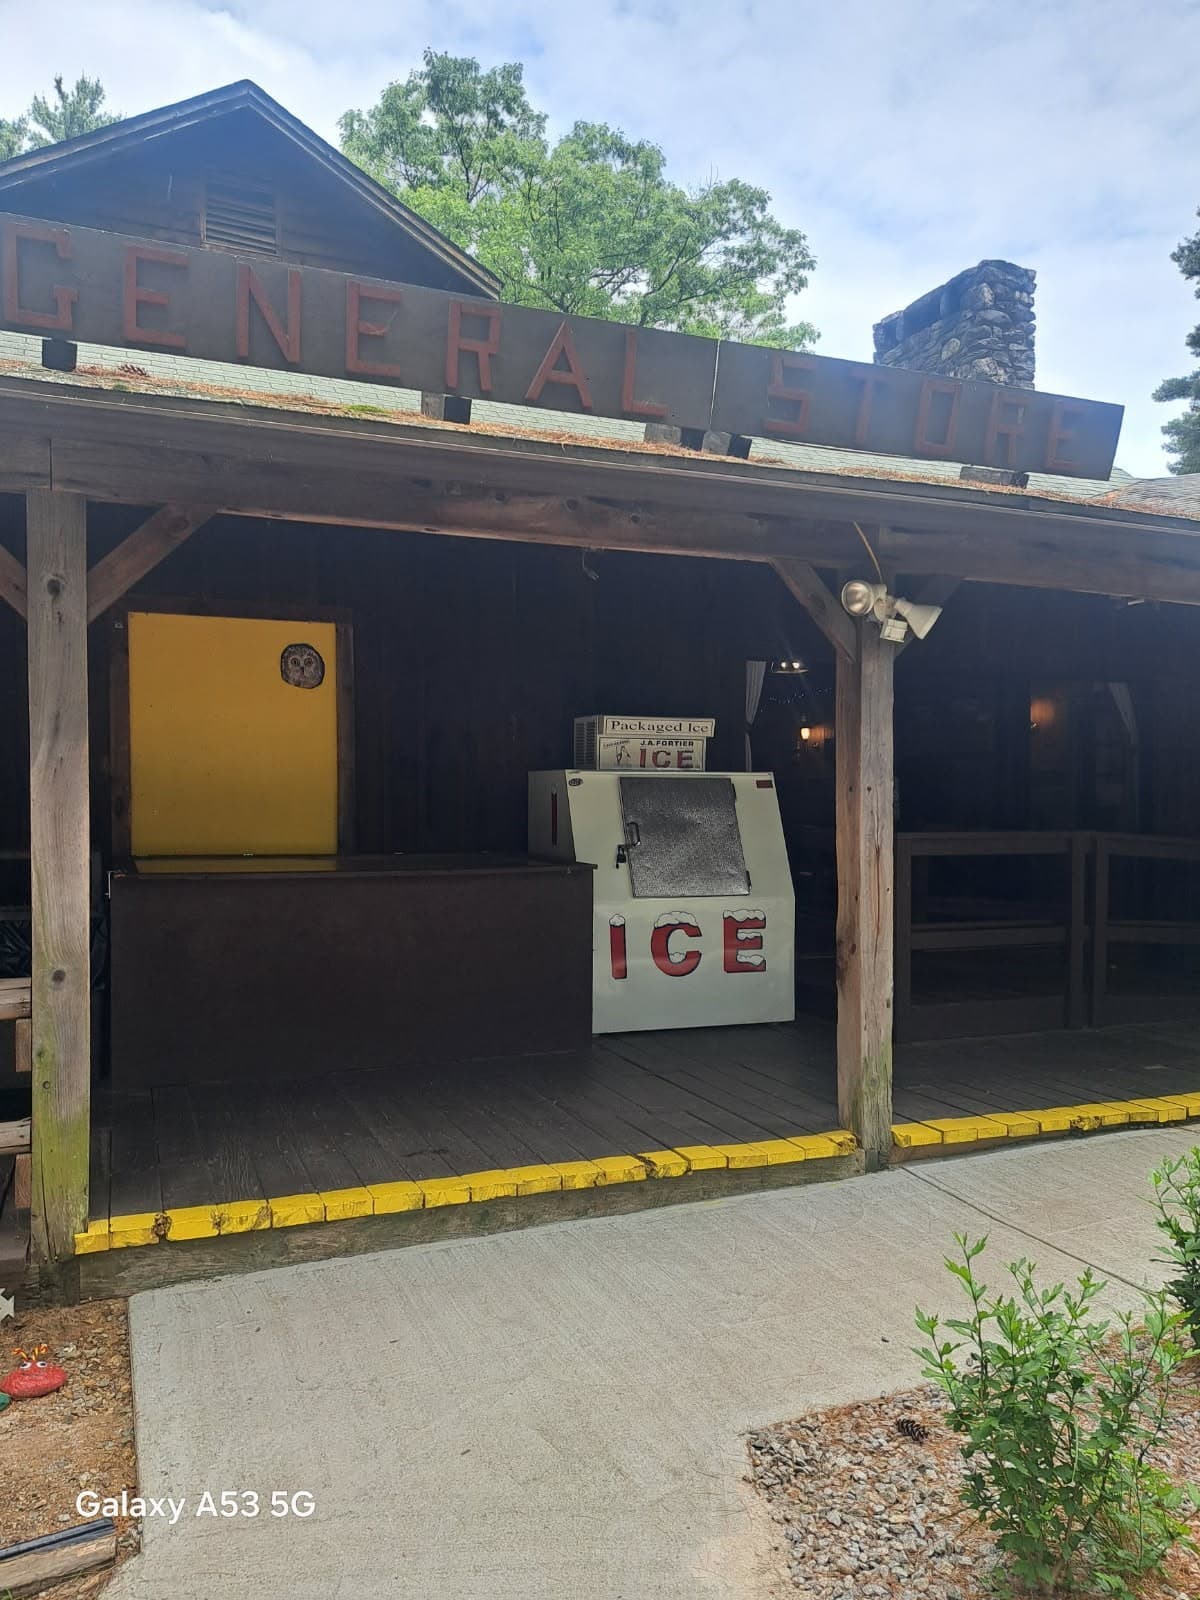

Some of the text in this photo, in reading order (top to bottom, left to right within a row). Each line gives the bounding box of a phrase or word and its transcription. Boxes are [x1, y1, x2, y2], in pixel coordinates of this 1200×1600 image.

[2, 223, 1087, 469] GENERAL STORE
[611, 720, 708, 733] Packaged Ice
[640, 749, 694, 768] ICE
[609, 909, 766, 980] ICE
